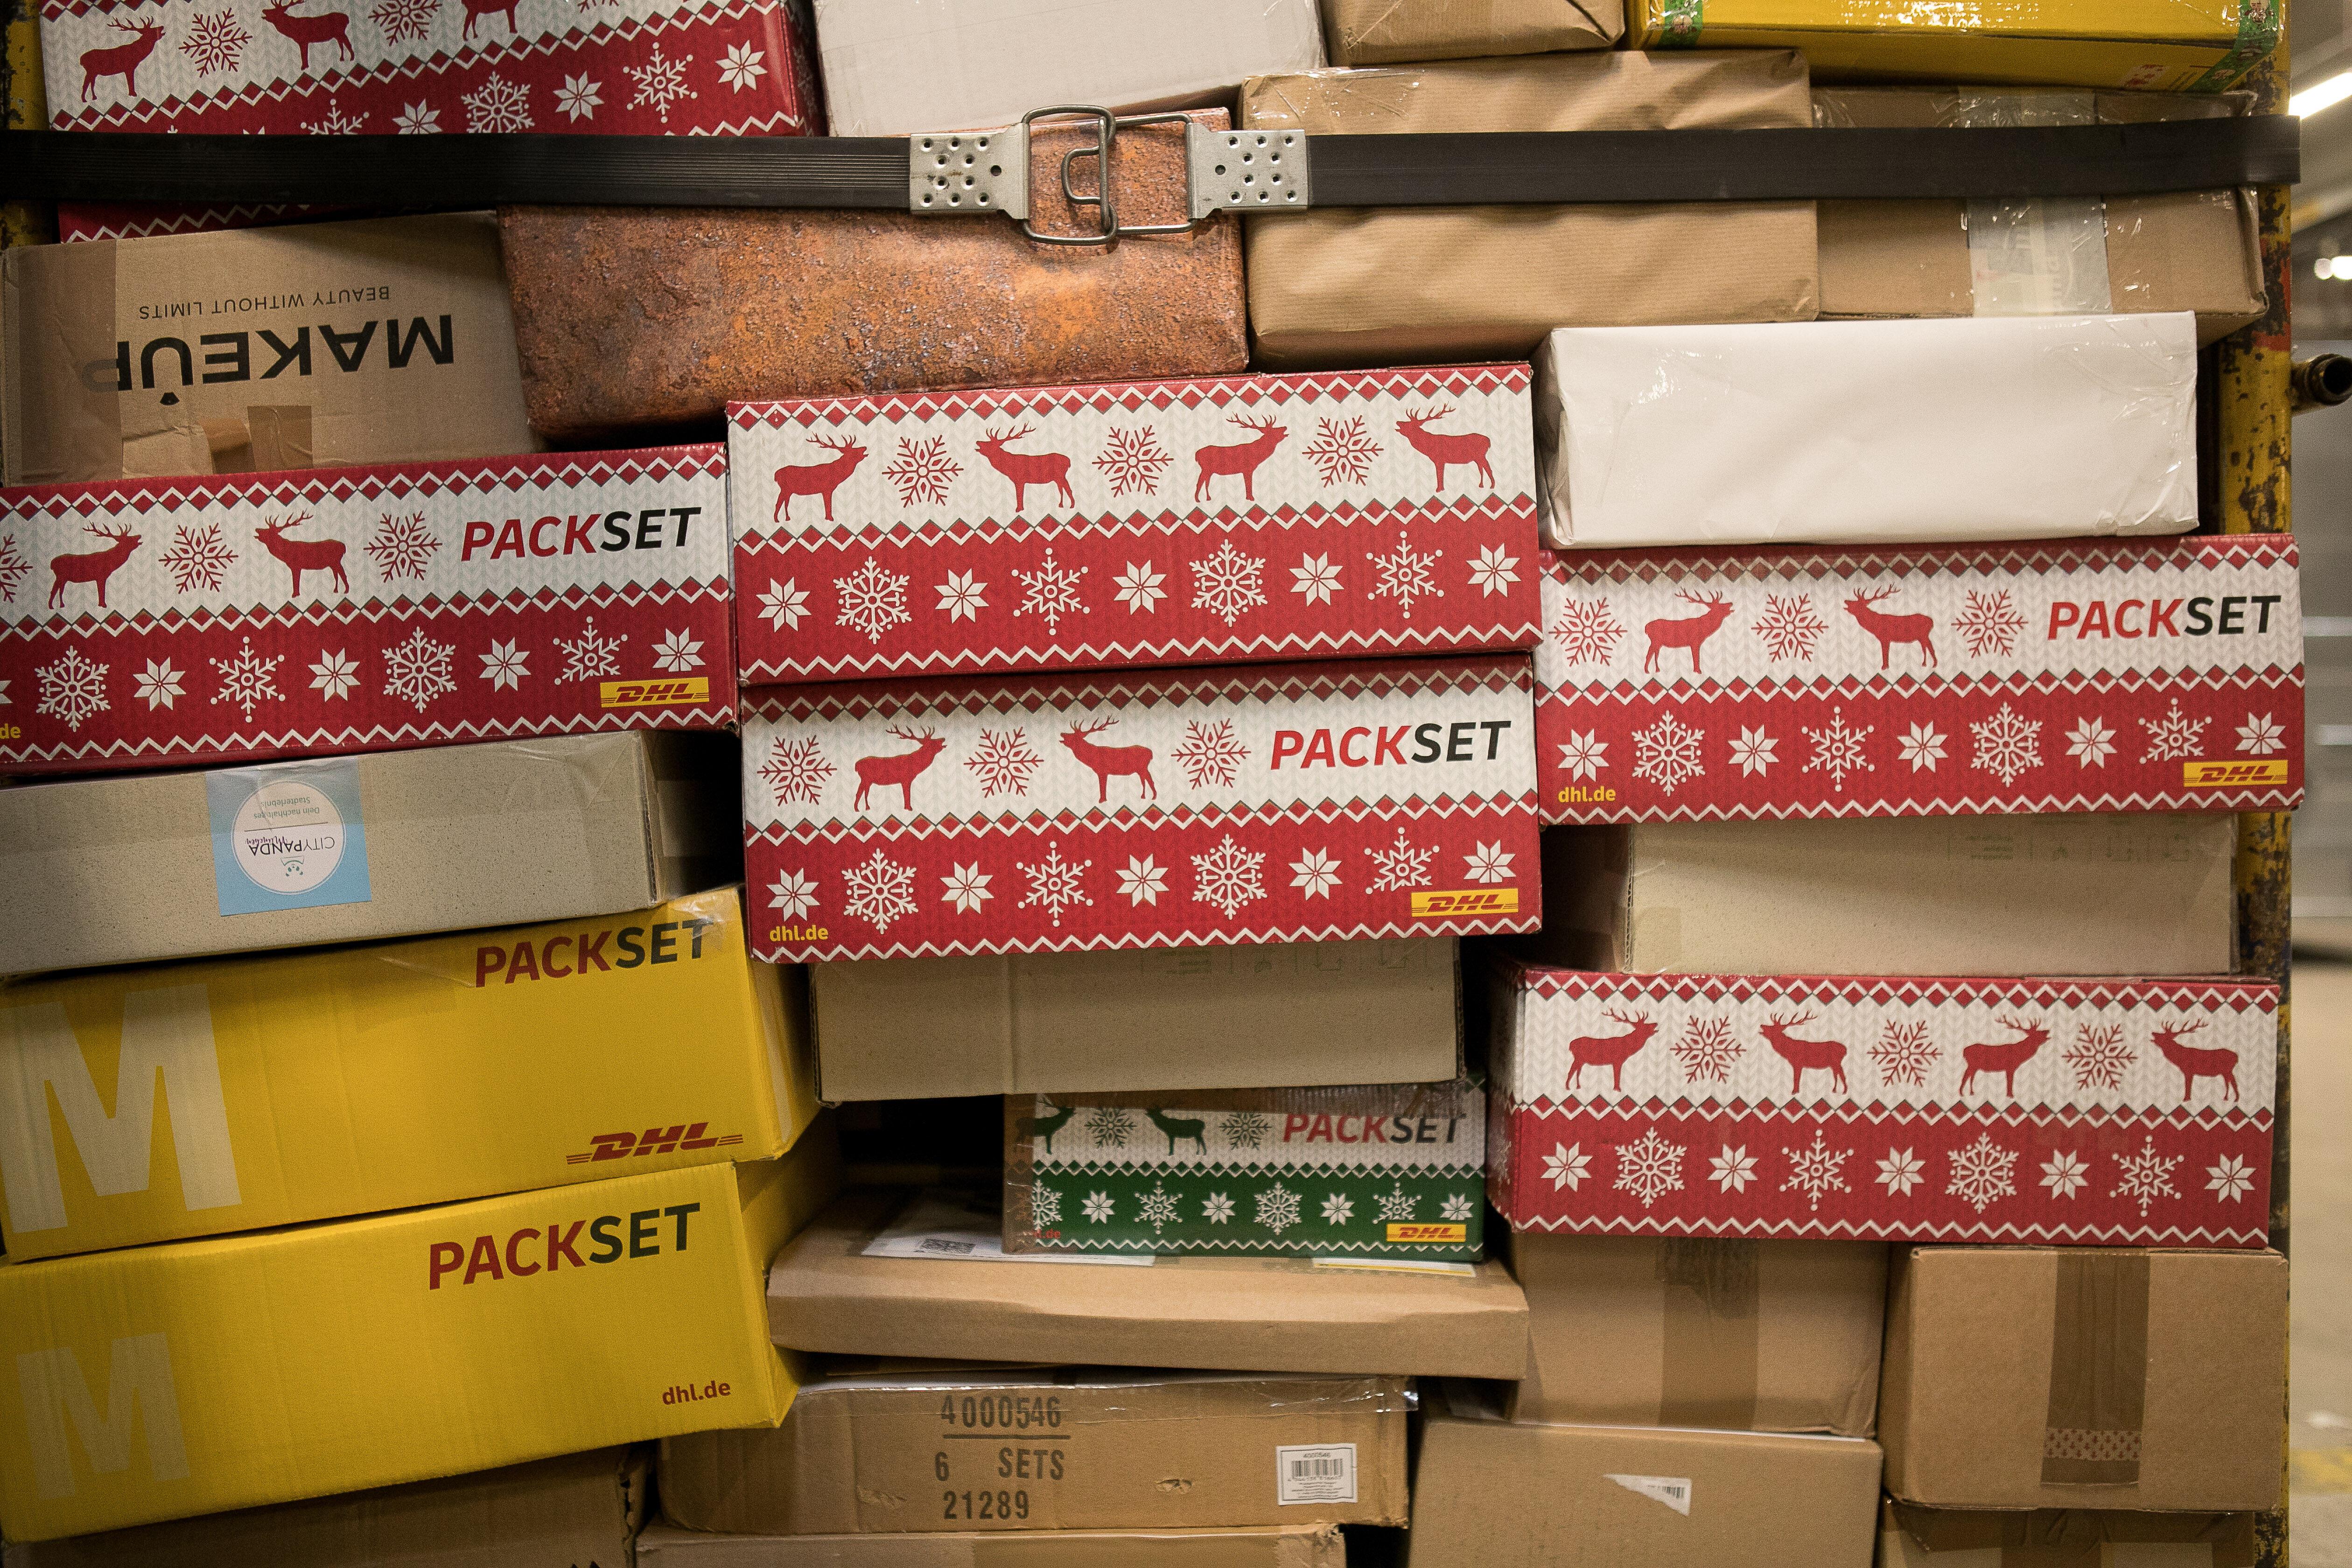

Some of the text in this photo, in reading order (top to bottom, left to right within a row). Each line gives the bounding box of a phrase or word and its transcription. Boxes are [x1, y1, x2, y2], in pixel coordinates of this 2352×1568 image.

[139, 286, 391, 320] BEAUTY WITHOUT LIMITS
[461, 506, 701, 562] PACKSET
[2048, 595, 2282, 641] PACKSET
[616, 683, 693, 703] DHL
[1271, 720, 1511, 770] PACKSET
[2198, 767, 2275, 785] DHL
[260, 797, 310, 808] Stadterlebnis
[1558, 786, 1616, 803] dhl.de
[249, 837, 335, 856] CITYPANDA
[1425, 894, 1504, 912] DHL
[769, 924, 829, 943] dhl.de
[476, 918, 713, 987] PACKSET
[0, 983, 242, 1233] M
[591, 1122, 719, 1162] DHL
[1283, 1113, 1466, 1143] PACKSET
[429, 1202, 700, 1291] PACKSET
[1399, 1227, 1456, 1239] DHL
[662, 1380, 730, 1405] dhl.de
[16, 1332, 191, 1499] M
[941, 1396, 1061, 1428] 4000546
[935, 1447, 1064, 1481] 6 SETS
[943, 1491, 1029, 1520] 21289
